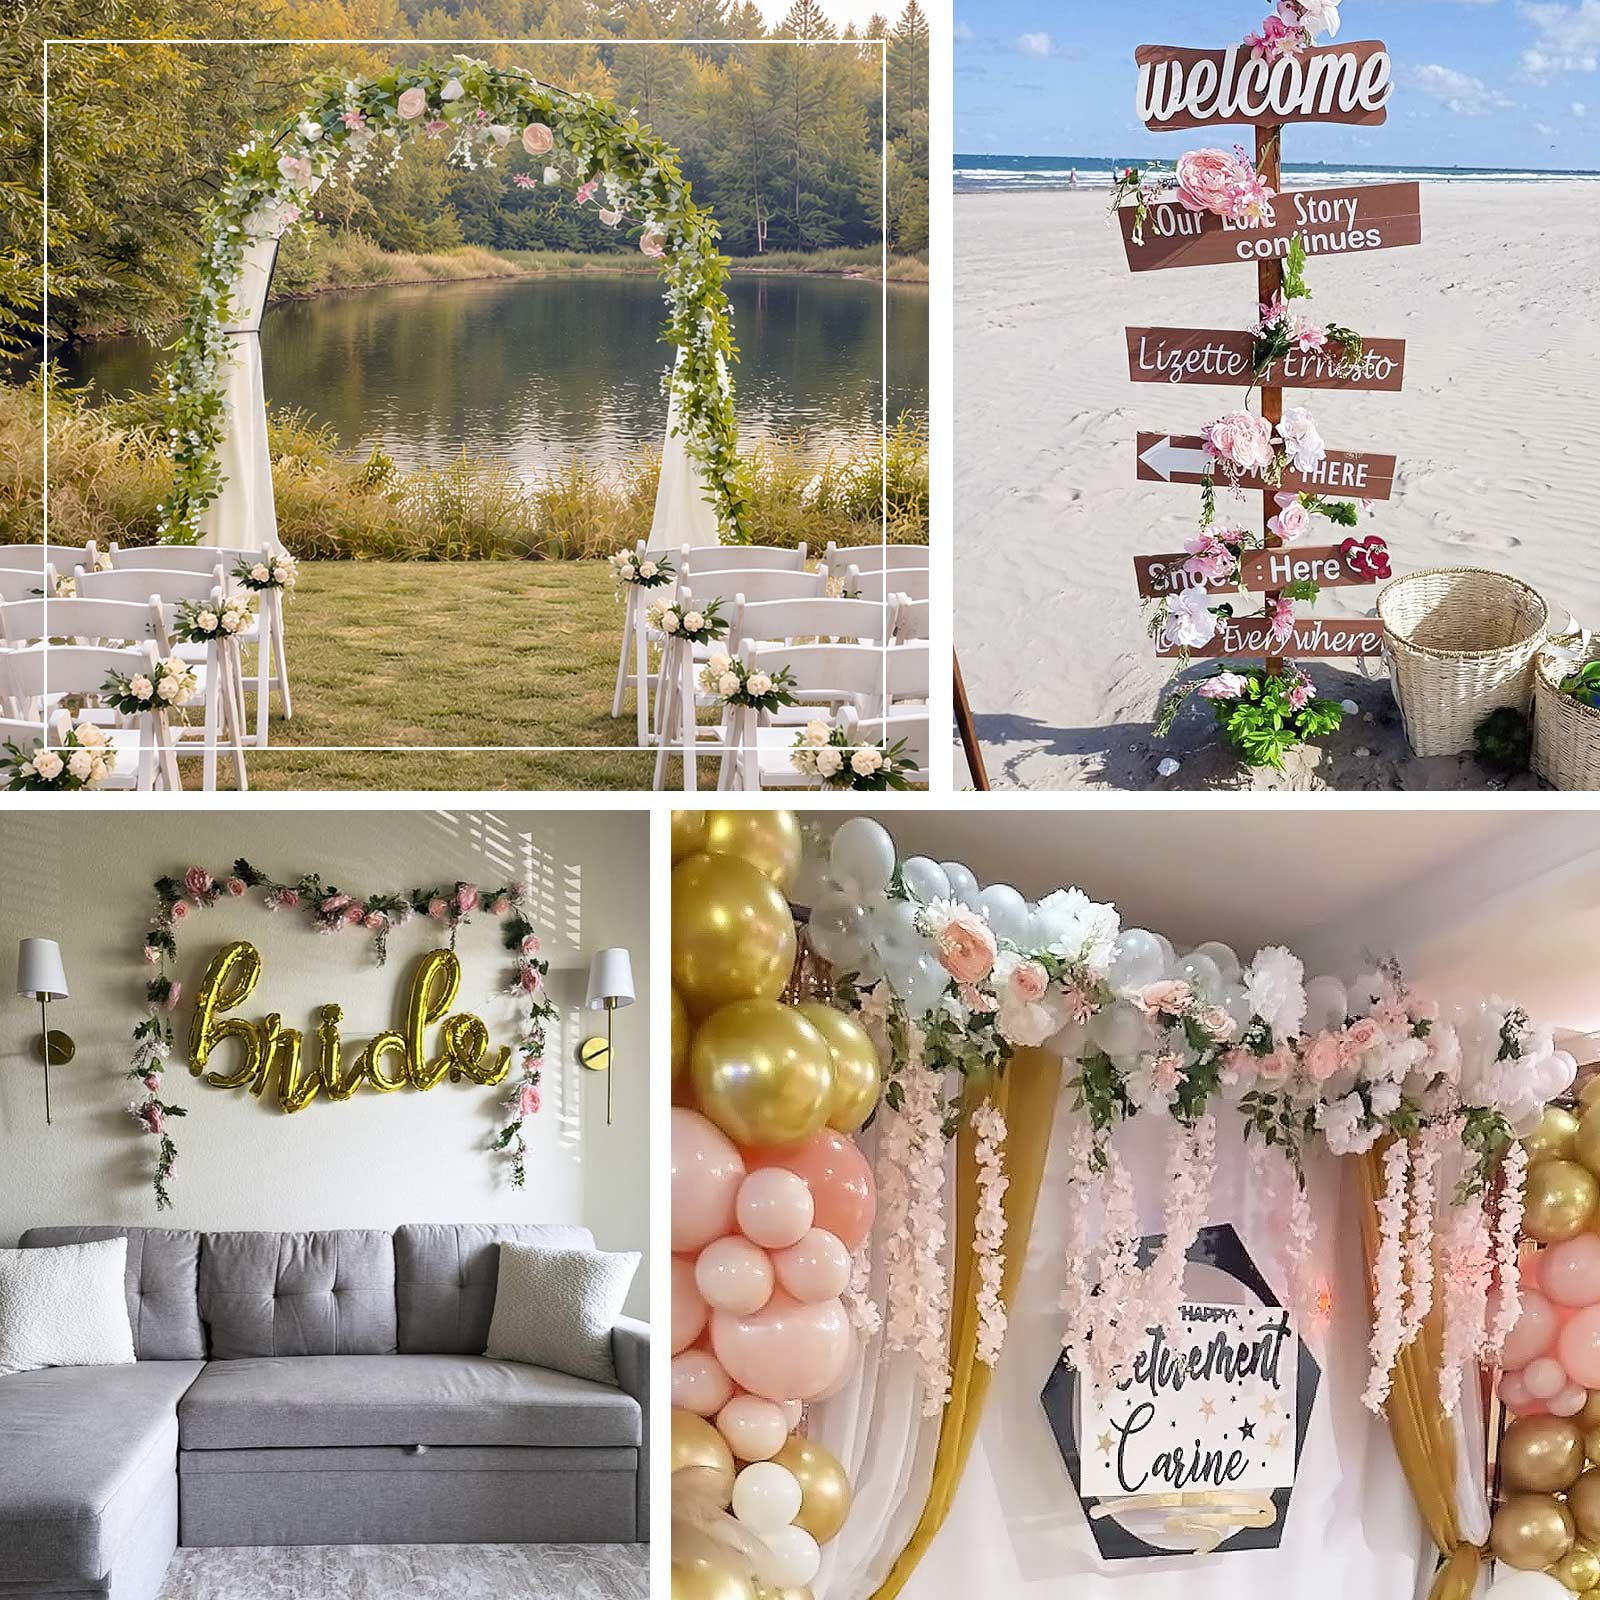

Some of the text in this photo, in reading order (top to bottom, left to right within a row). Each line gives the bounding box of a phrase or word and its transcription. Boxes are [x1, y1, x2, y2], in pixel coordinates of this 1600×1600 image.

[1136, 44, 1394, 122] welcome
[1157, 204, 1204, 237] Our
[1294, 193, 1358, 231] Story
[1138, 336, 1249, 384] Lizette
[1269, 554, 1340, 584] Here
[187, 940, 512, 1114] bride
[1180, 1305, 1232, 1324] HAPPY
[1110, 1402, 1250, 1492] Carine
